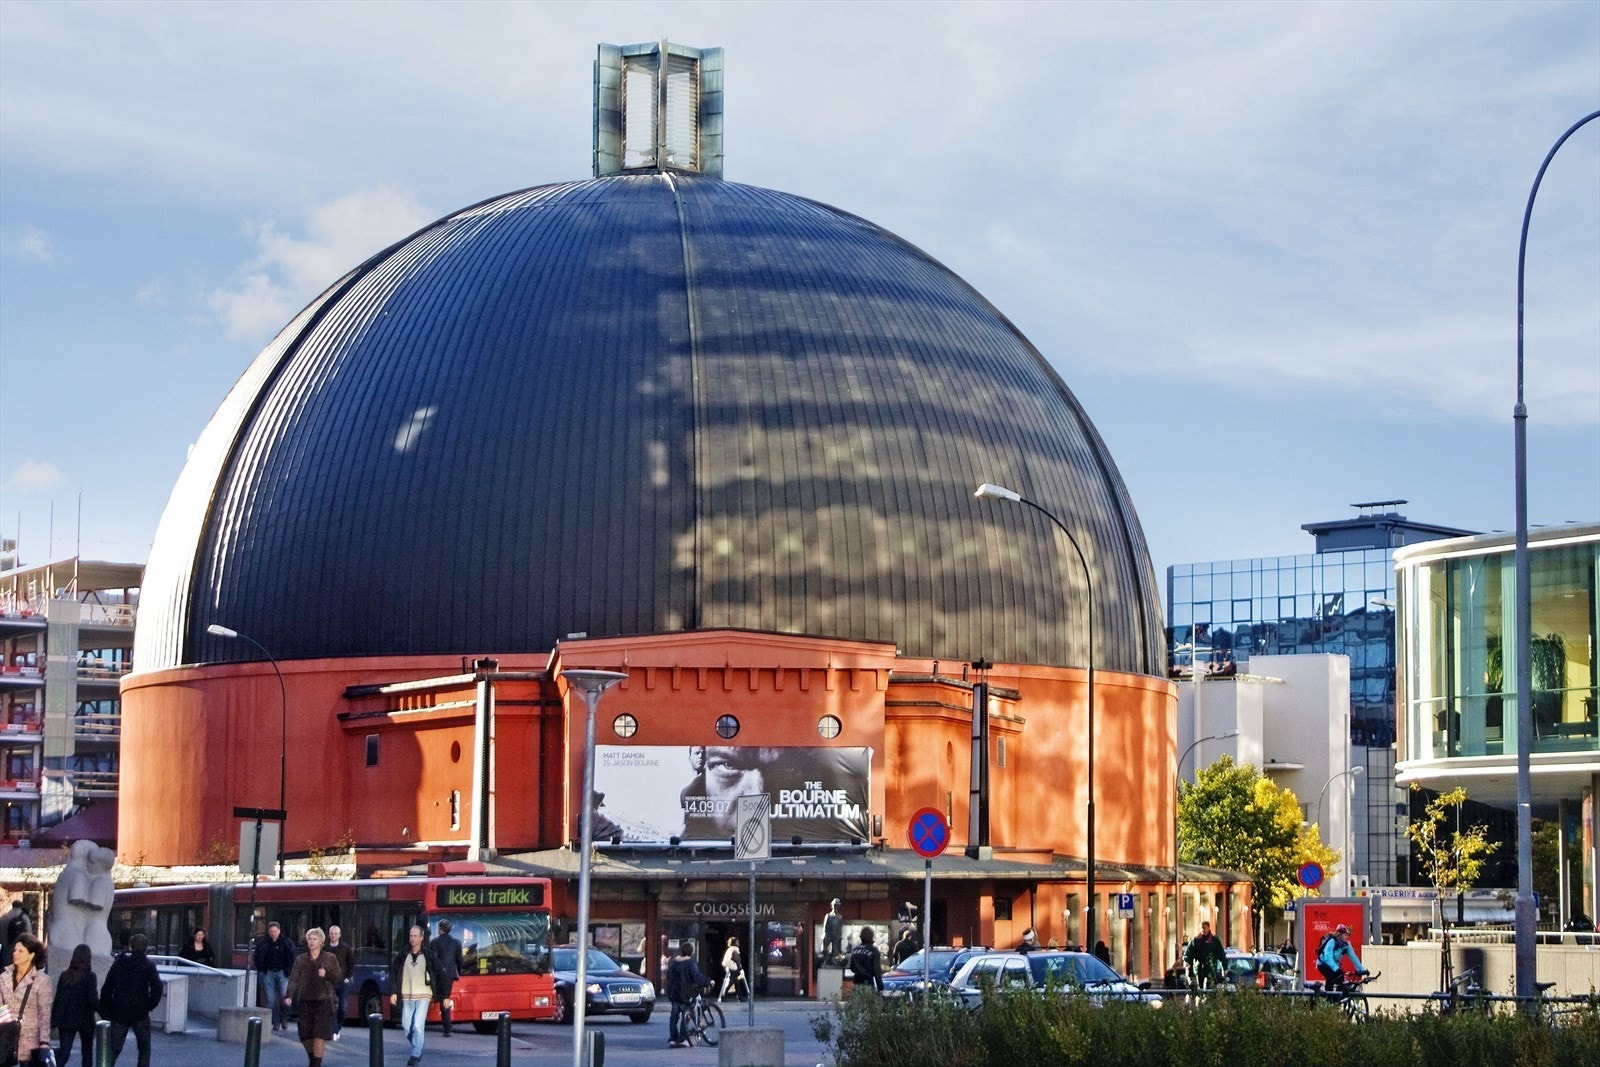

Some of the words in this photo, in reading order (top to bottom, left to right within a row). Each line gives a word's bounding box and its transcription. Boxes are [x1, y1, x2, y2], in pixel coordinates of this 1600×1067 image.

[804, 781, 822, 789] THE
[780, 790, 847, 804] BOURNE
[684, 801, 731, 813] 14.09.07
[769, 804, 860, 818] ULTIMATUM
[448, 889, 476, 904] Ikke
[480, 889, 484, 904] i
[488, 888, 530, 904] trafikk
[1122, 895, 1130, 908] P
[693, 902, 775, 915] COLOSSEUM
[1286, 901, 1293, 910] P
